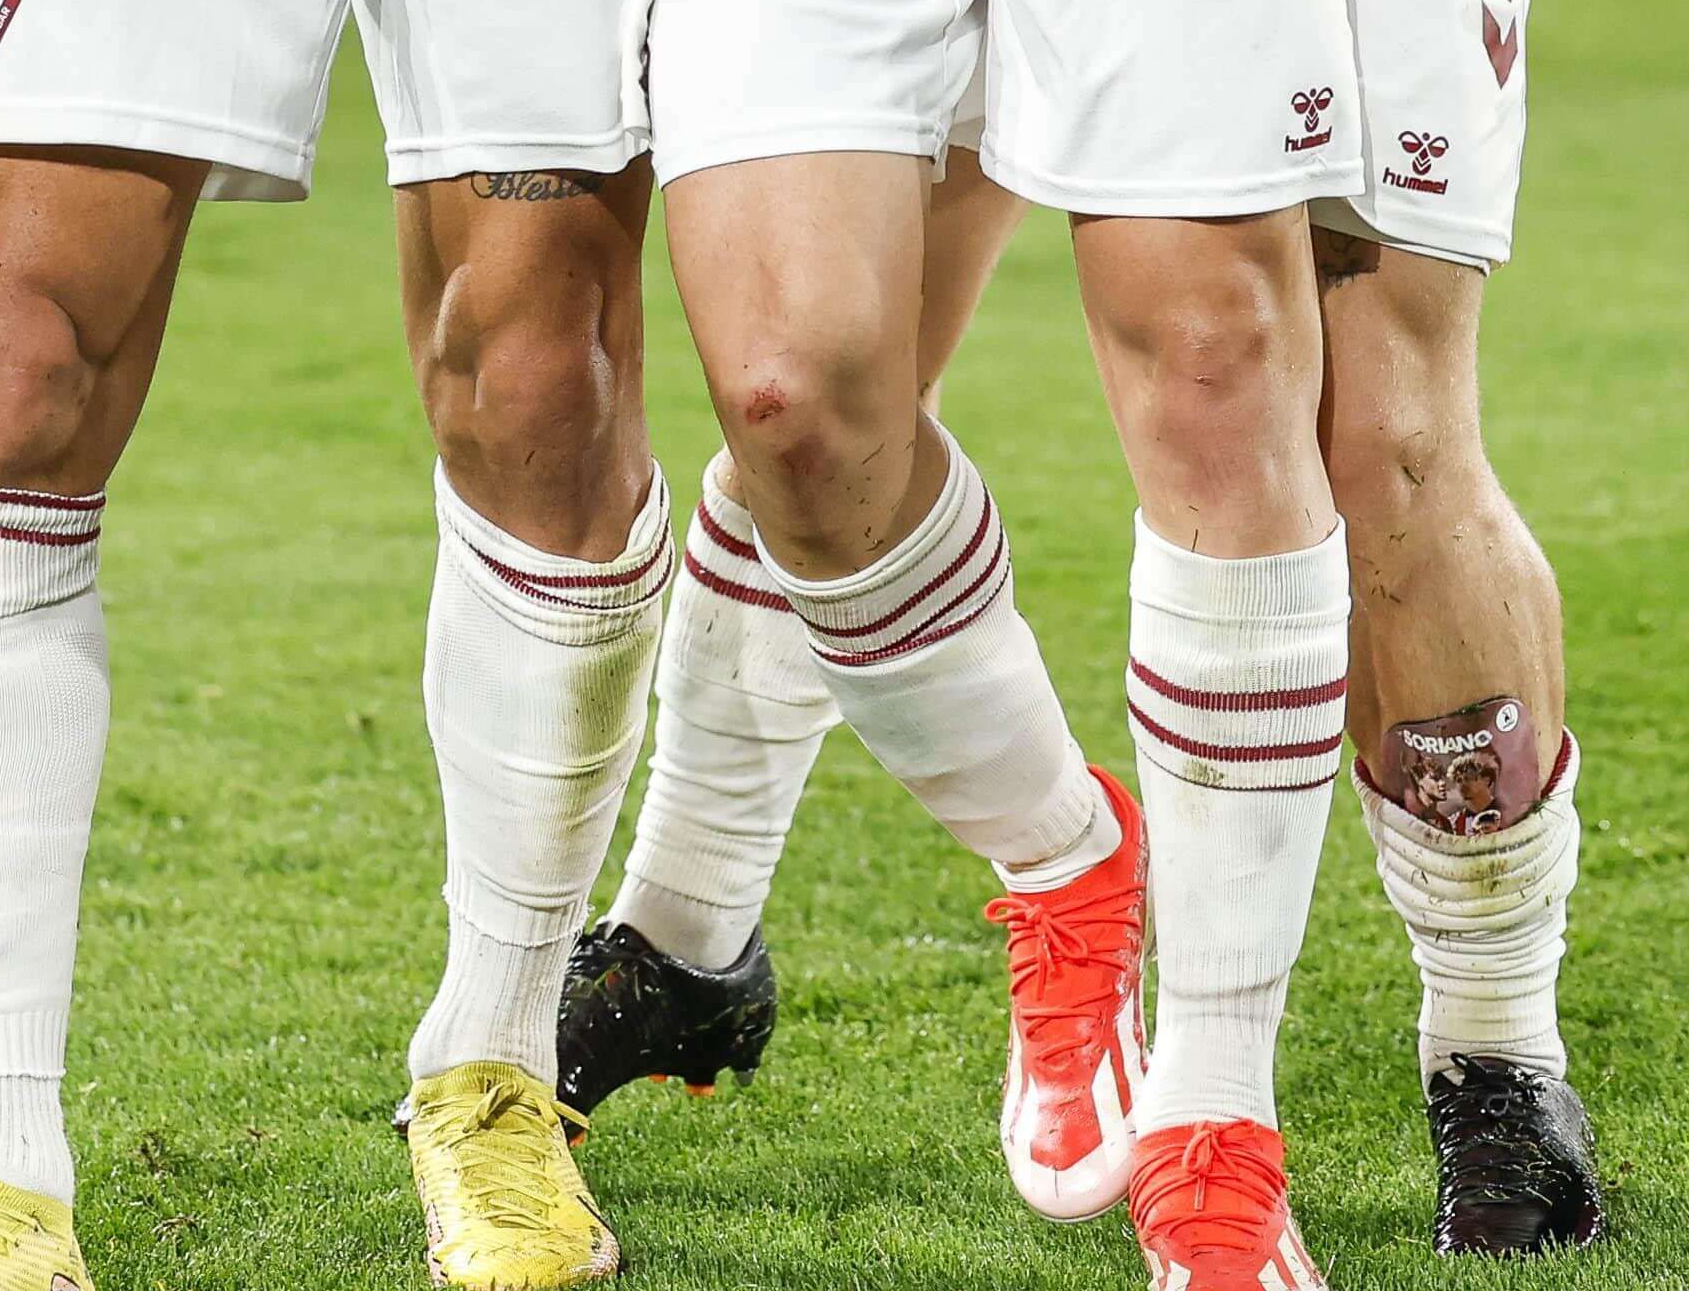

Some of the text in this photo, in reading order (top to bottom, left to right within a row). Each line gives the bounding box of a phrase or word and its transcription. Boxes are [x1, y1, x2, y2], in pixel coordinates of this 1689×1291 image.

[1285, 125, 1332, 153] hummel
[1382, 167, 1449, 195] hummel
[1402, 729, 1494, 755] SORIANO
